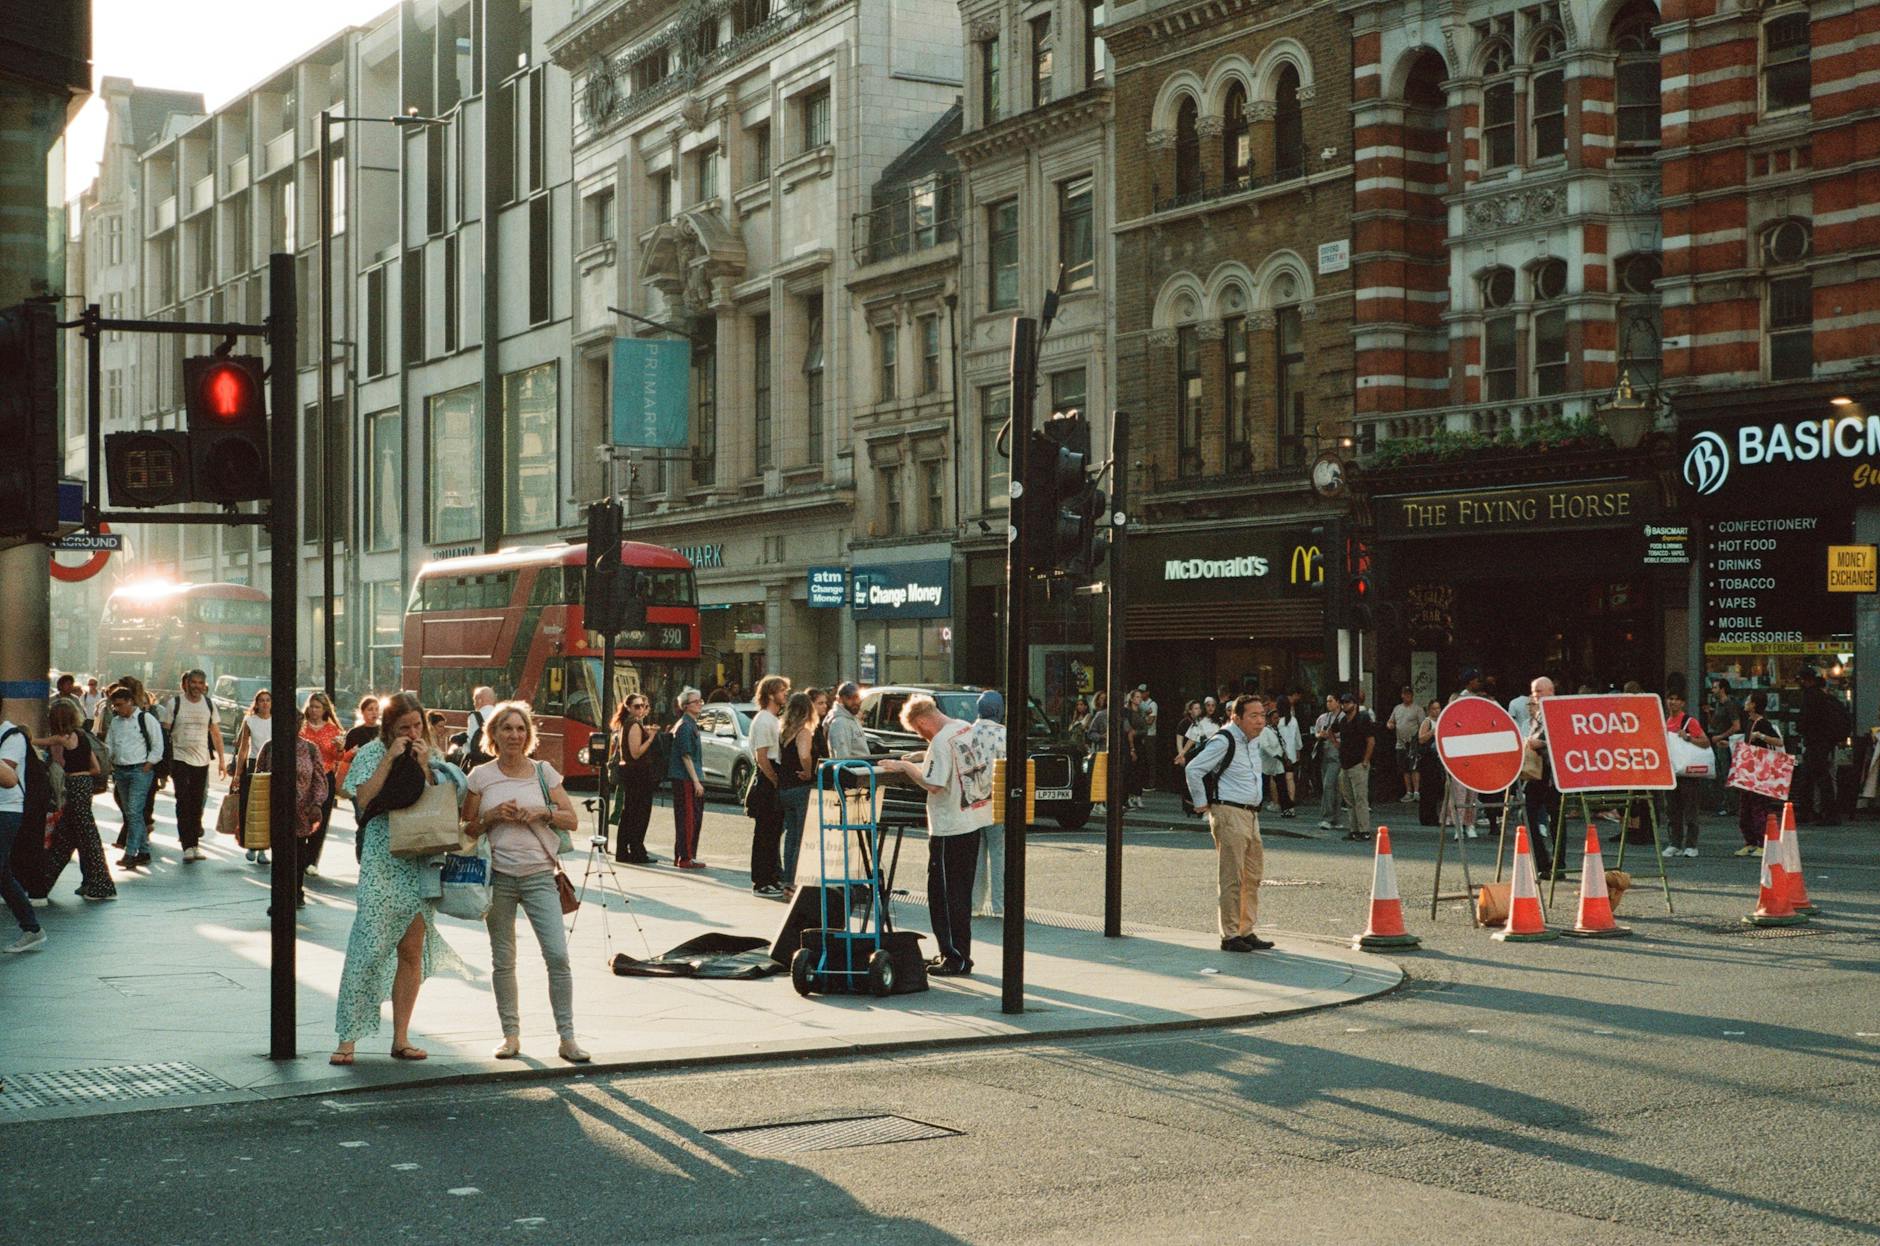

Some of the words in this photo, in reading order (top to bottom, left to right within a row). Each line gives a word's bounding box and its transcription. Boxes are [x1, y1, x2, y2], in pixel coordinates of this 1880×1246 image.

[644, 344, 657, 438] PRIMARK
[1403, 504, 1447, 528] THE
[1458, 499, 1536, 524] FLYING
[1549, 493, 1630, 519] HORSE
[1651, 527, 1688, 535] BASICMART
[1718, 518, 1817, 532] CONFECTIONERY
[1718, 540, 1741, 551] HOT
[1744, 539, 1777, 550] FOOD
[1718, 559, 1761, 570] DRINKS
[1837, 552, 1867, 567] MONEY
[1165, 556, 1268, 580] McDonald's
[813, 571, 842, 582] atm
[1830, 570, 1874, 586] EXCHANGE
[811, 584, 844, 594] Change
[1718, 578, 1776, 589] TOBACCO
[813, 594, 842, 604] Money
[870, 585, 907, 608] Change
[908, 583, 942, 606] Money
[1718, 597, 1756, 608] VAPES
[1718, 617, 1763, 628] MOBILE
[661, 628, 682, 644] 390
[1718, 631, 1803, 643] ACCESSORIES
[1571, 712, 1640, 735] ROAD
[1565, 748, 1660, 773] CLOSED
